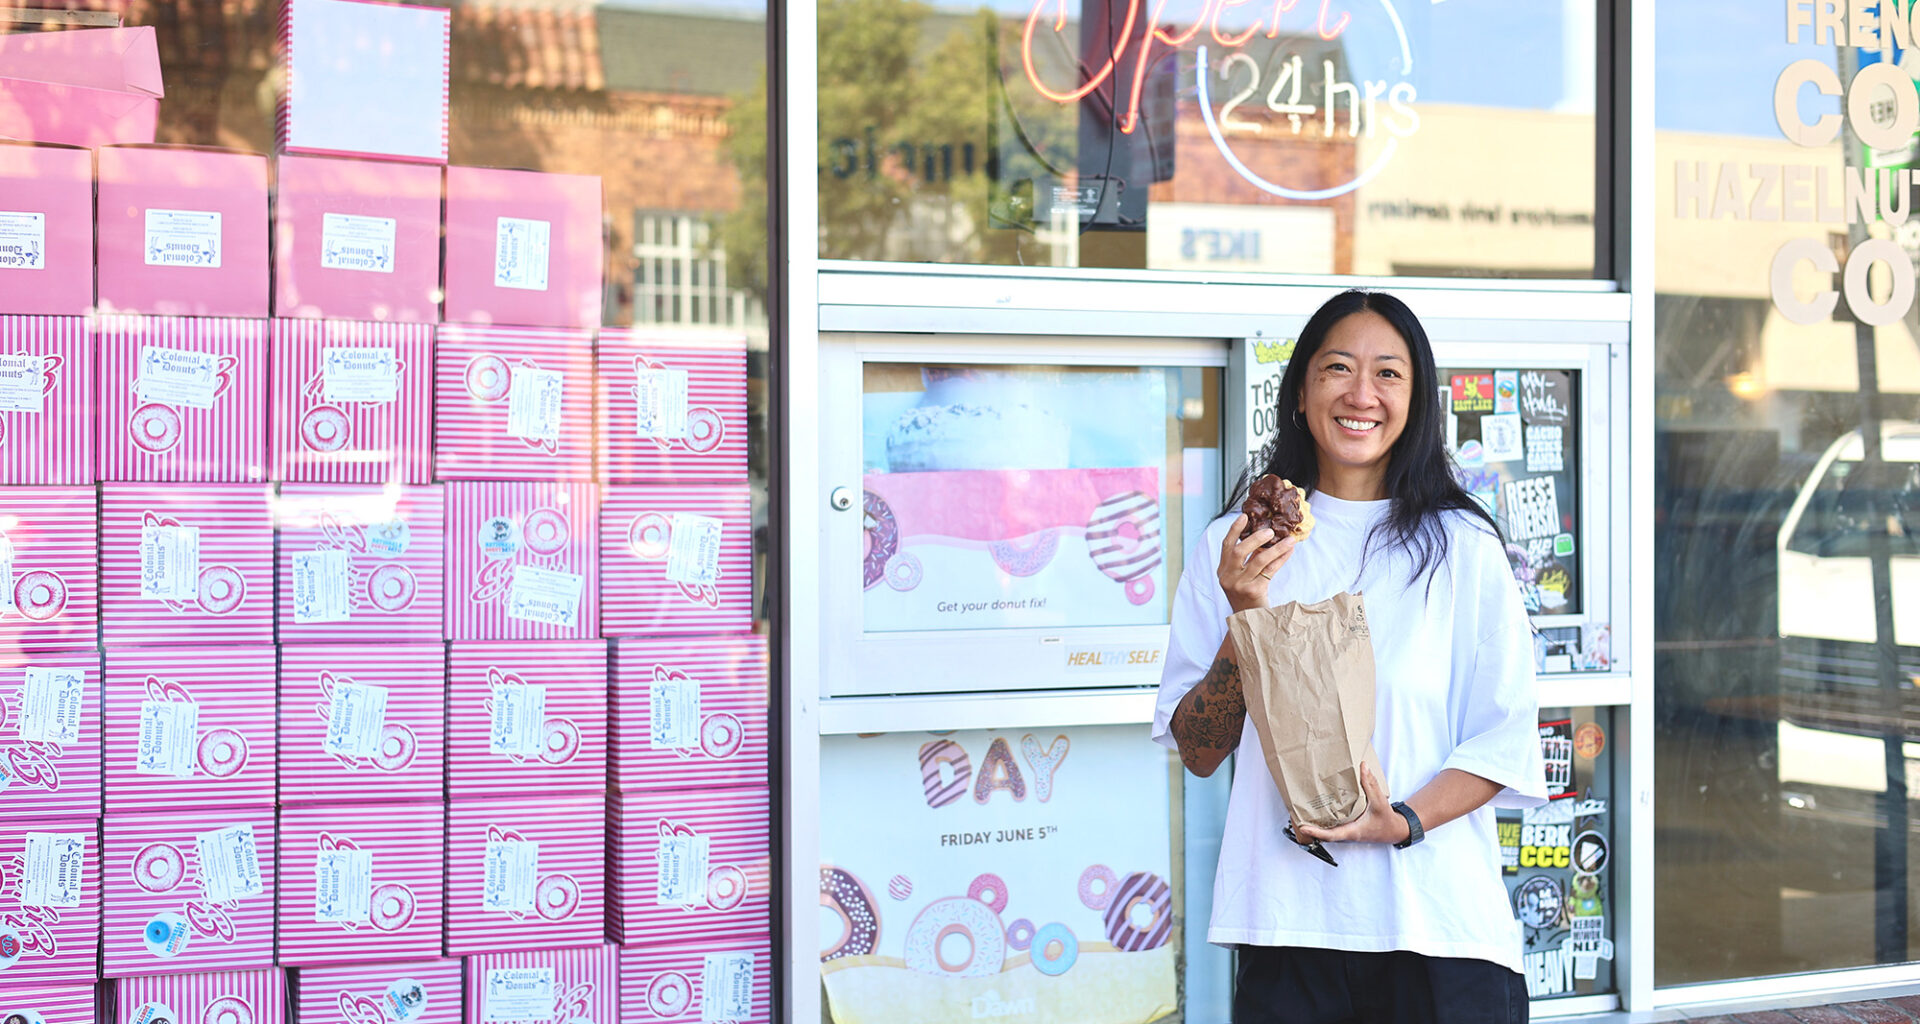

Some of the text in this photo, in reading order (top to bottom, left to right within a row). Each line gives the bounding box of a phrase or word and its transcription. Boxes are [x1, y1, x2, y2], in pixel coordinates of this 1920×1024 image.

[1022, 0, 1352, 133] Open
[1219, 52, 1421, 138] 24 hrs
[160, 351, 200, 364] Colonial
[162, 361, 196, 375] Donuts
[340, 350, 379, 360] Colonial
[343, 360, 376, 370] Donuts
[144, 544, 154, 581] Colonial
[155, 546, 165, 579] Donuts
[937, 597, 1047, 614] Get your donut fix!
[57, 690, 70, 723] Donuts
[67, 688, 81, 727] Colonial
[141, 718, 153, 756] Colonial
[152, 720, 164, 754] Donuts
[918, 733, 1070, 808] DAY
[940, 825, 1058, 847] FRIDAY JUNE 5TH
[1521, 824, 1571, 847] BERK
[57, 854, 70, 887] Donuts
[69, 851, 82, 890] Colonial
[244, 841, 258, 878] Colonial
[1520, 845, 1570, 868] CCC
[319, 867, 328, 904] Colonial
[503, 971, 539, 980] Colonial
[1524, 950, 1574, 998] HEAVY
